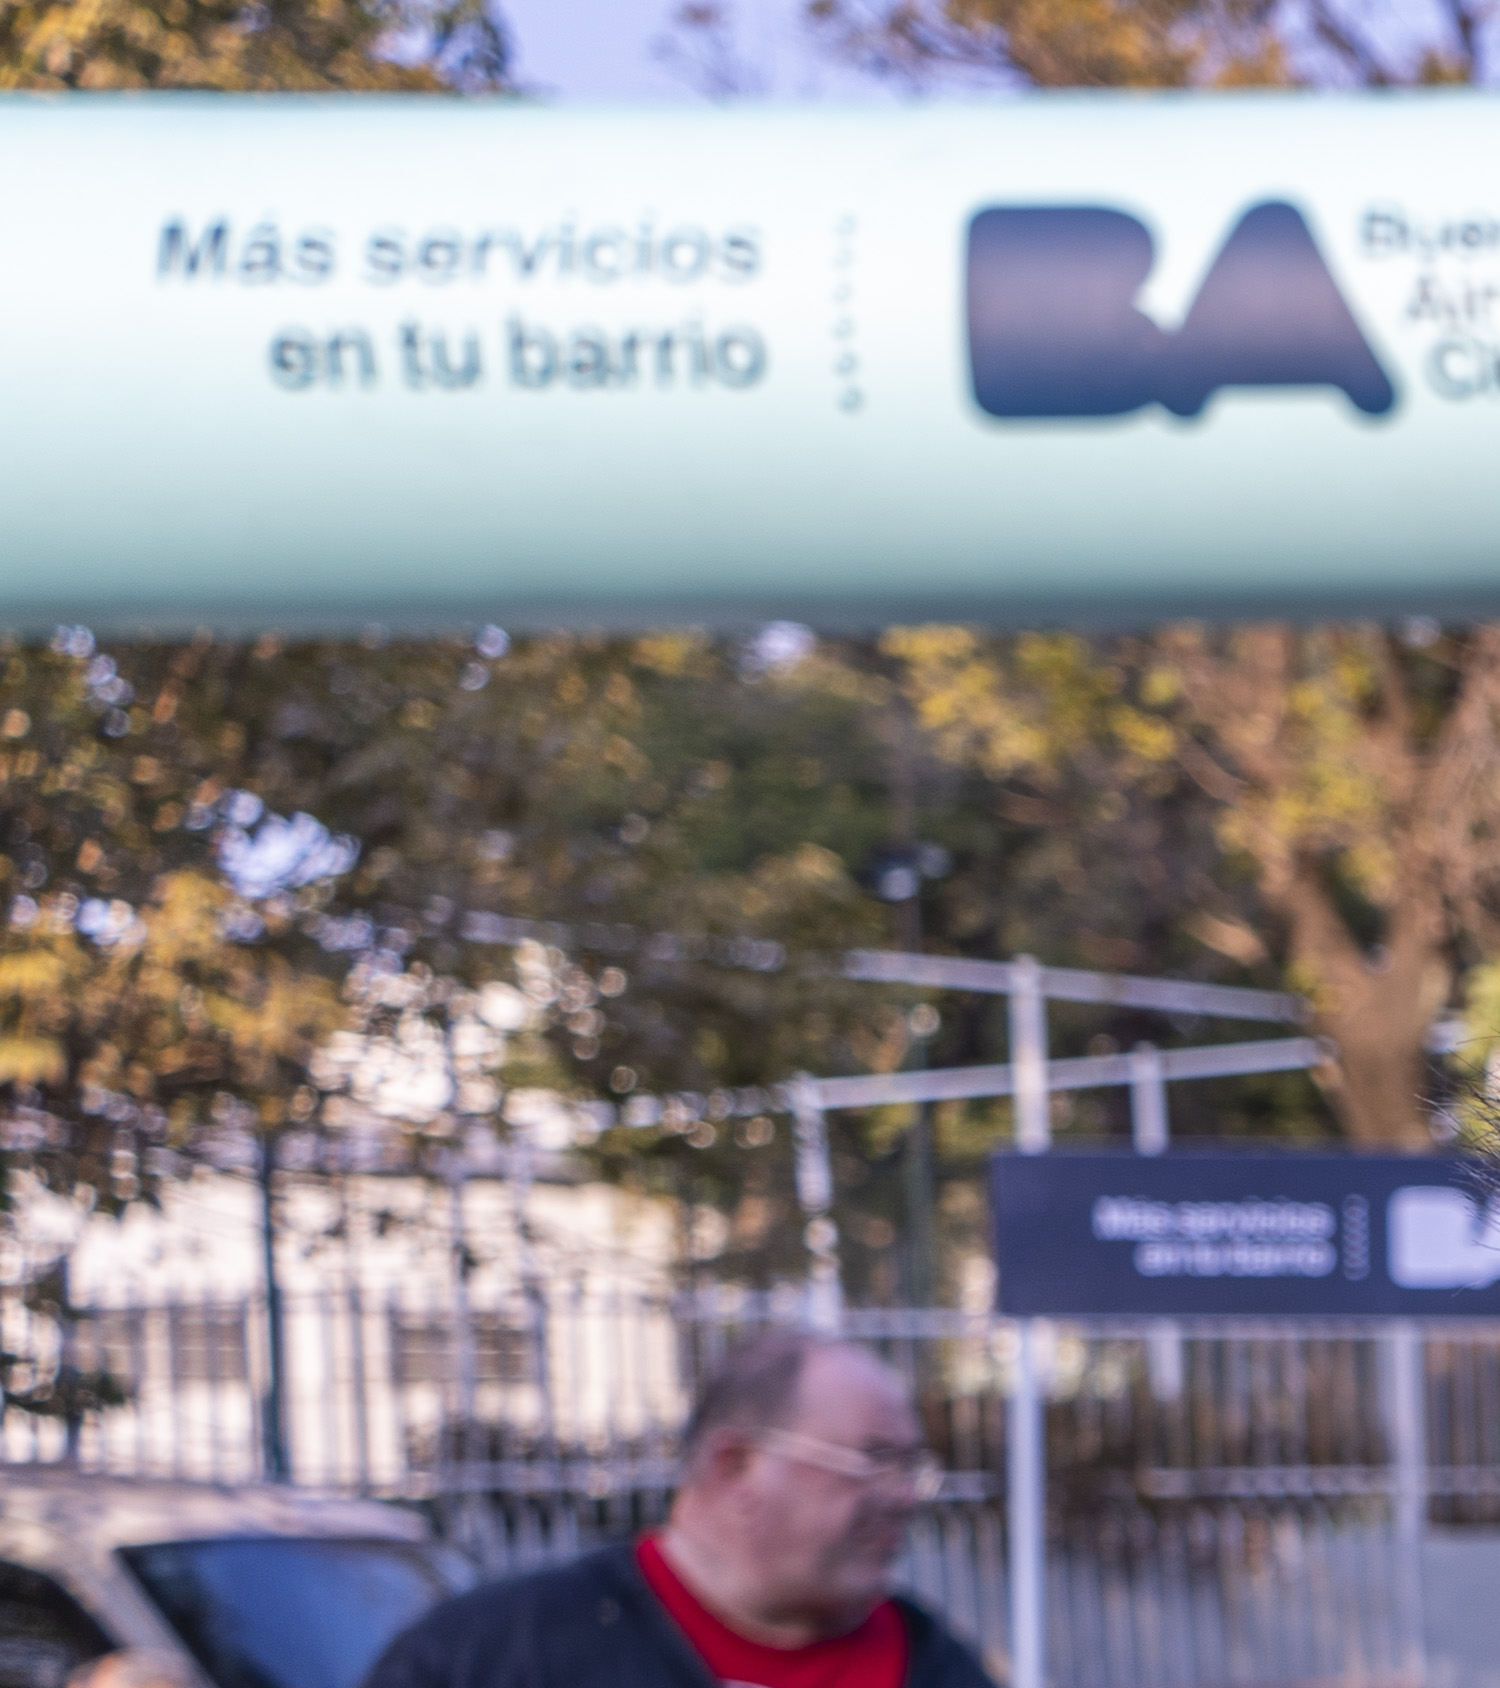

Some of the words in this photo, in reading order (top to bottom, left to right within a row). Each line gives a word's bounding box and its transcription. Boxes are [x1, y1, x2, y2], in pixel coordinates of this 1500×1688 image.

[156, 212, 334, 284] Más
[364, 208, 766, 286] servicios
[268, 326, 380, 392] en
[400, 312, 484, 392] tu
[506, 306, 770, 394] barrio
[966, 200, 1394, 418] BA
